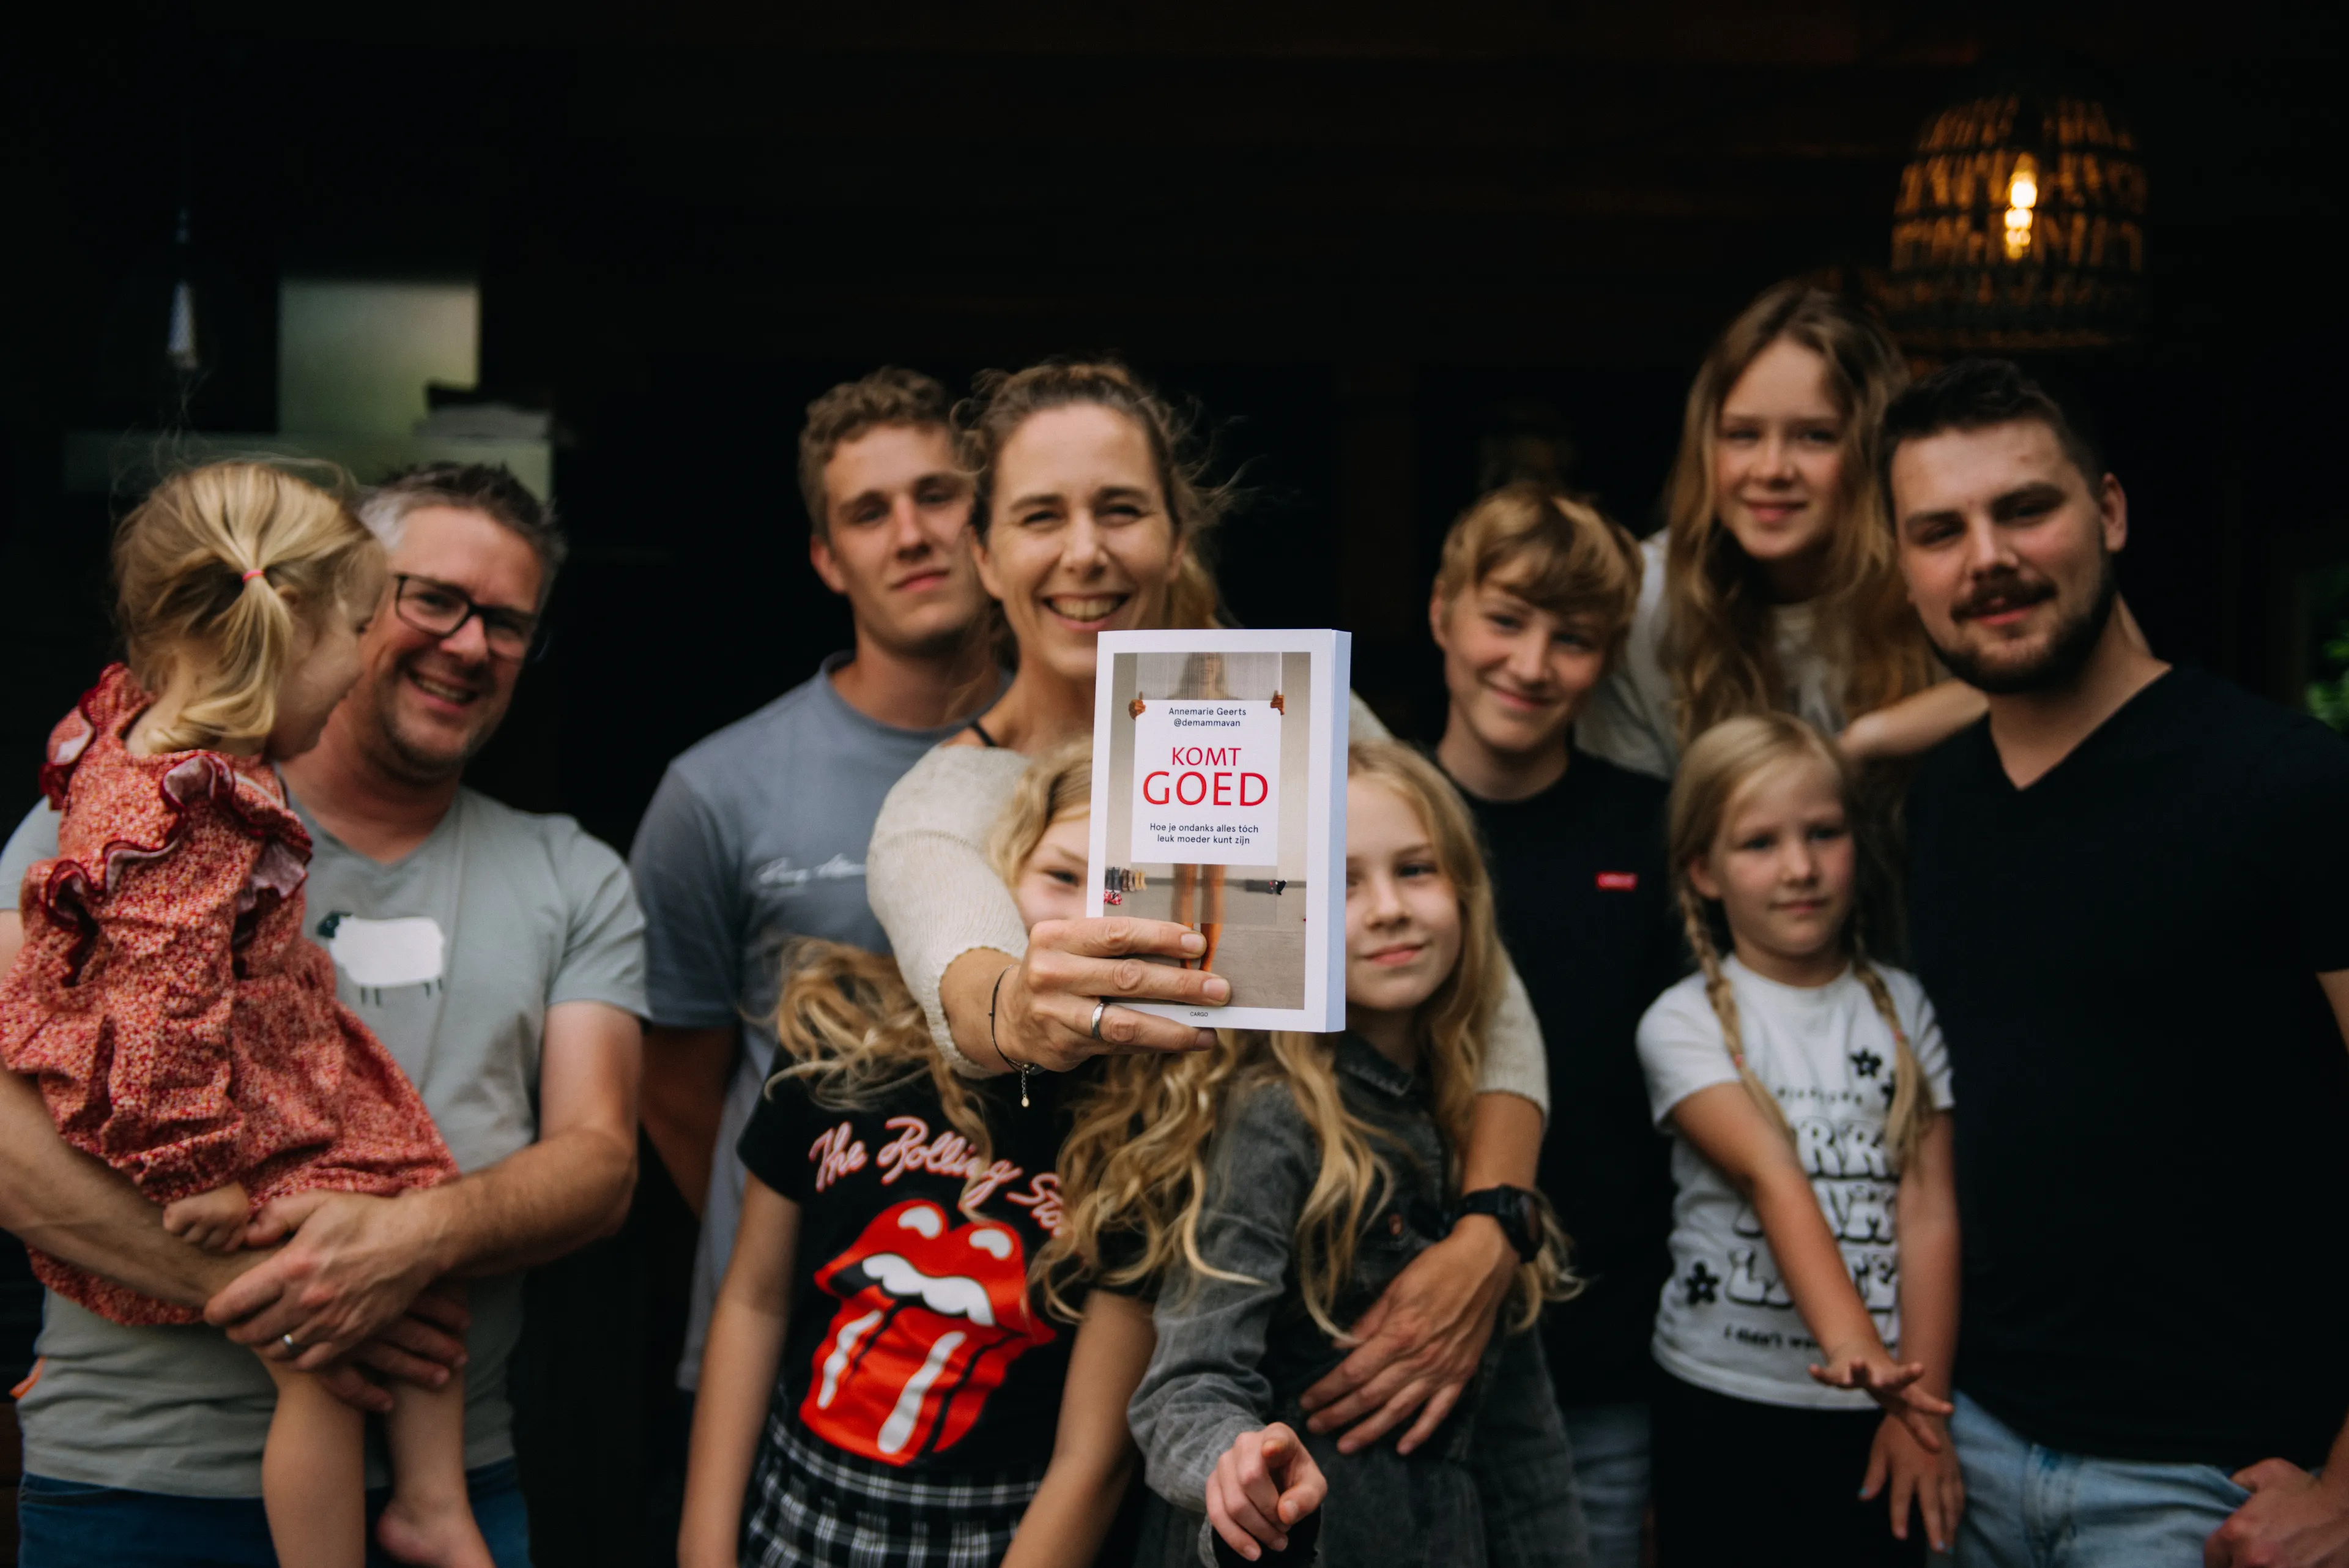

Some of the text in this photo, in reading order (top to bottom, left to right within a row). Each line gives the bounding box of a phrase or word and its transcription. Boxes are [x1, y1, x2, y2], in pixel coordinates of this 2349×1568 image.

[1168, 707, 1247, 716] Annemarie Geerts
[1173, 718, 1241, 727] @demammavan
[1172, 747, 1242, 766] KOMT
[1143, 771, 1268, 806] GOED
[1149, 823, 1167, 831] Hoe
[1168, 823, 1176, 833] je
[1216, 824, 1236, 833] alles
[1239, 825, 1259, 833] tóch
[1157, 834, 1250, 846] leuk moeder kunt zijn
[809, 1121, 867, 1193] The
[876, 1115, 1023, 1211] Rolling
